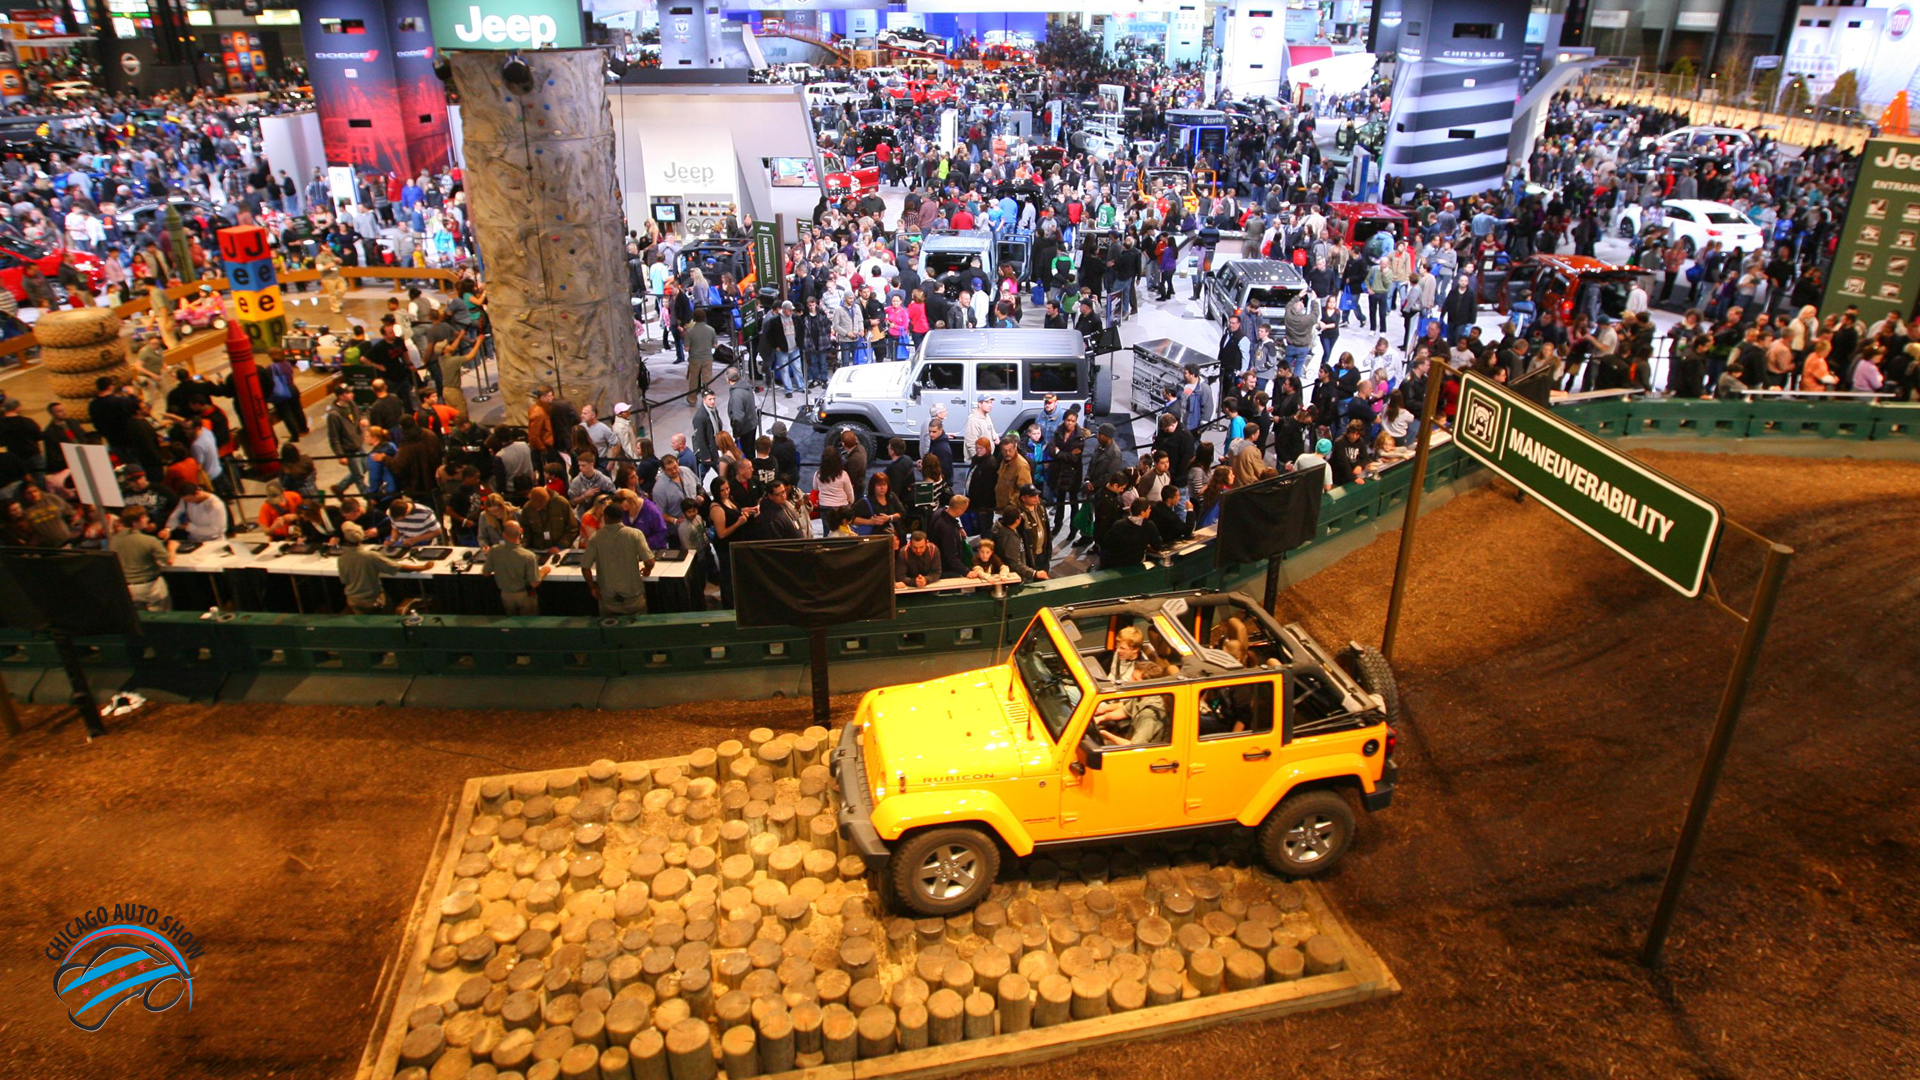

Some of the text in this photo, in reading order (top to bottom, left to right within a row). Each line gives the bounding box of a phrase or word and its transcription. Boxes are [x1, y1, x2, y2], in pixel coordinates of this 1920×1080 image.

[455, 5, 557, 49] Jeep
[396, 50, 428, 58] DODGE
[1443, 50, 1505, 58] CHRYSLER
[663, 161, 714, 183] Jeep
[1098, 212, 1108, 225] 19
[763, 237, 771, 264] CLIMBING
[1508, 427, 1675, 542] MANEUVERABILITY
[923, 773, 994, 784] RUBICON
